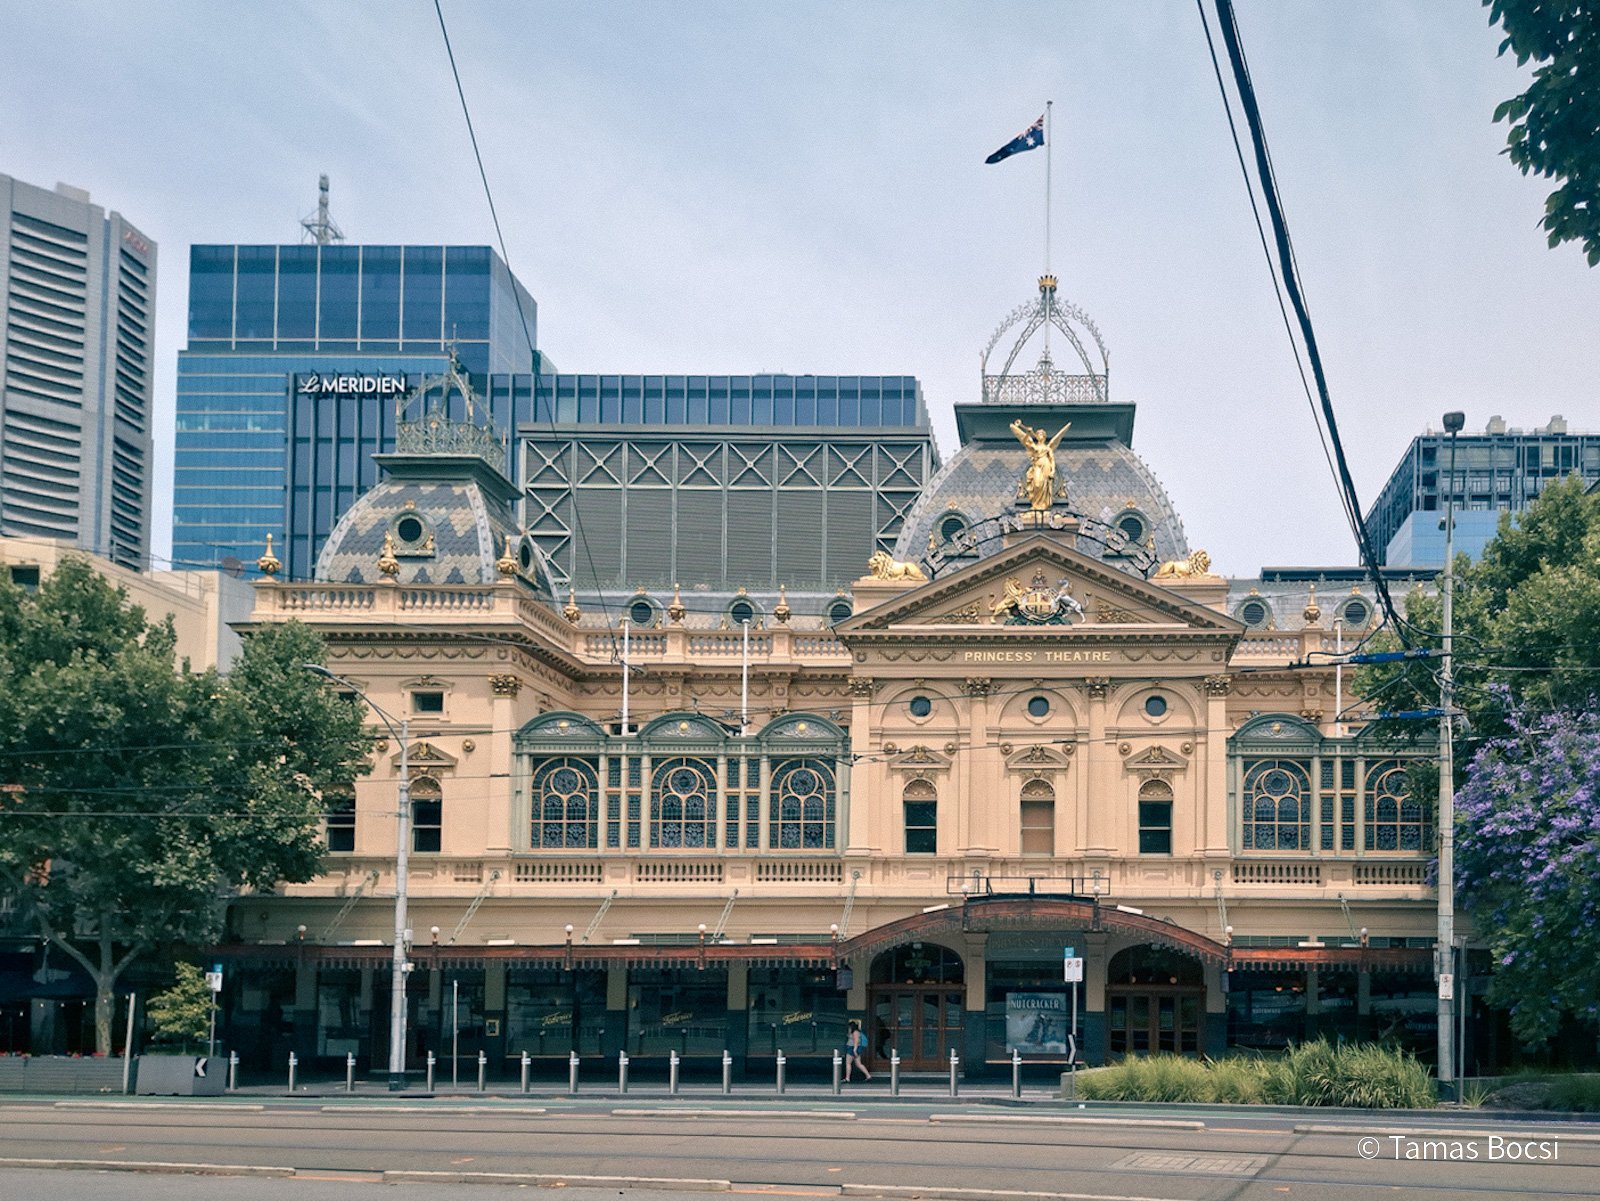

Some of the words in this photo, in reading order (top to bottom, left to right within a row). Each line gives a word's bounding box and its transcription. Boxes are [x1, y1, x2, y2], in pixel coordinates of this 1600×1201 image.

[298, 375, 320, 393] Le
[321, 376, 406, 393] MERIDIEN
[924, 508, 1158, 575] PRINCESS
[1045, 651, 1112, 663] THEATRE
[1010, 999, 1060, 1009] NUTCRACKER
